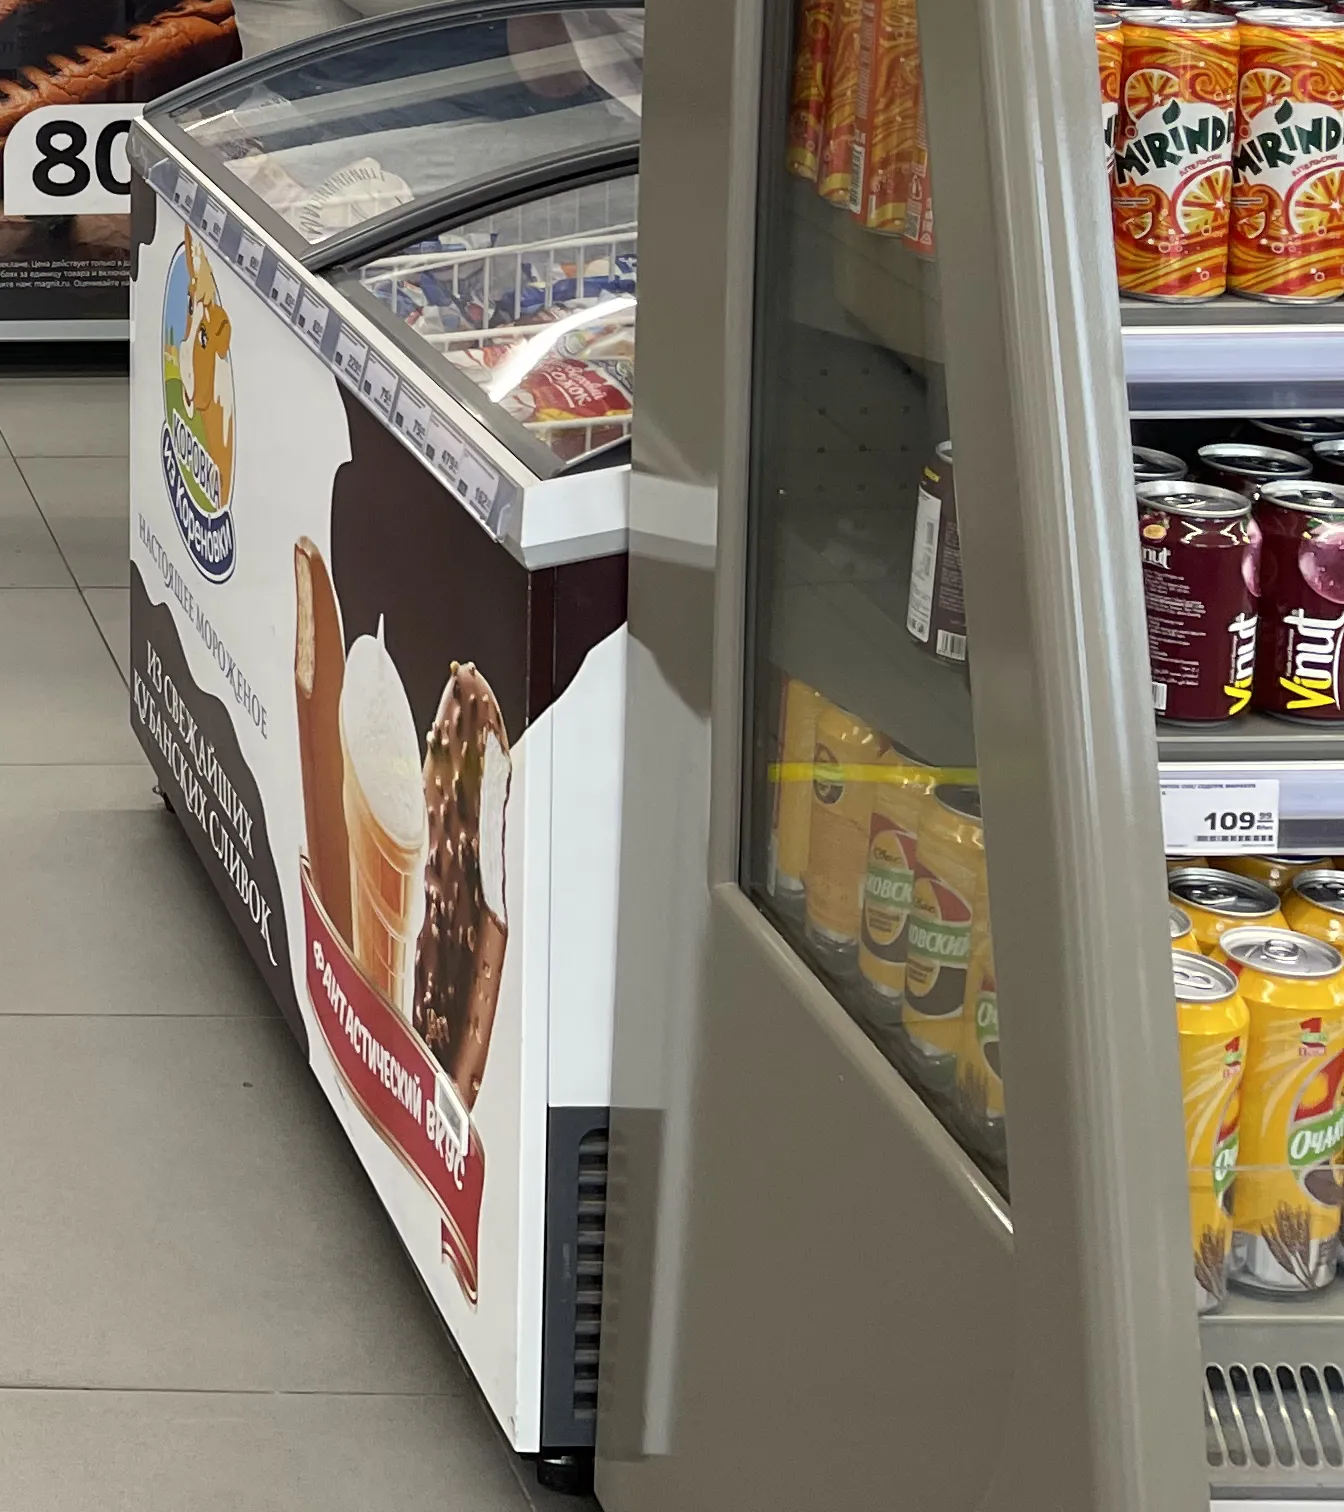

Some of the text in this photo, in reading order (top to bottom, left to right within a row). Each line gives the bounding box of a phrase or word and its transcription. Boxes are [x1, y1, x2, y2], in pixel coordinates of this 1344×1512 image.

[52, 259, 90, 268] действует
[172, 407, 222, 513] КОРОВКА
[138, 513, 269, 740] НАСТОЯЩЕЕ МОРОЖЕНОЕ
[133, 668, 279, 967] КУБАНСКИХ СЛИВОК
[164, 665, 254, 857] СВЕЖАЙШИХ
[1204, 811, 1256, 830] 109
[312, 939, 424, 1126] ФАНТАСТИЧЕСКИЙ
